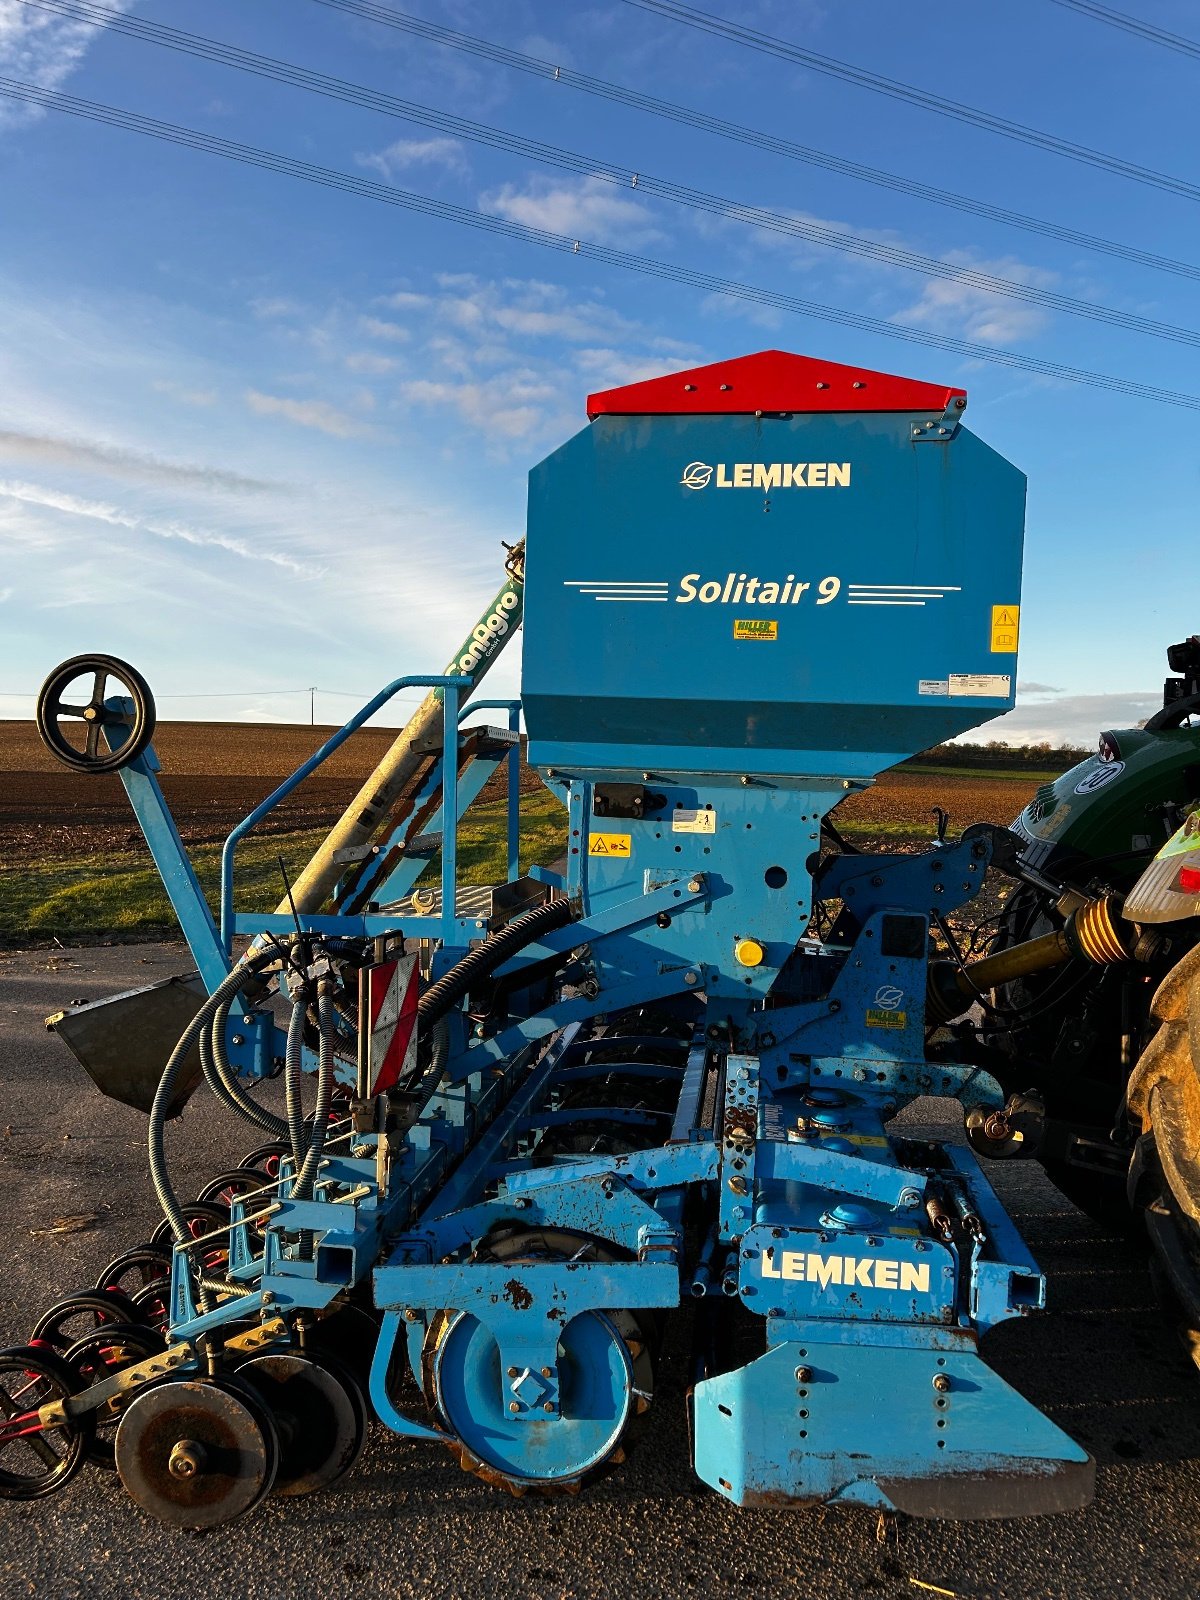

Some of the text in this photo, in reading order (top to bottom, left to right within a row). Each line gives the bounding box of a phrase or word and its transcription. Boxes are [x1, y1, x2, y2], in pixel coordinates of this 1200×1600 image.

[717, 463, 851, 494] LEMKEN
[675, 573, 841, 605] Solitair 9
[486, 638, 501, 657] GmbH
[762, 1249, 930, 1293] LEMKEN
